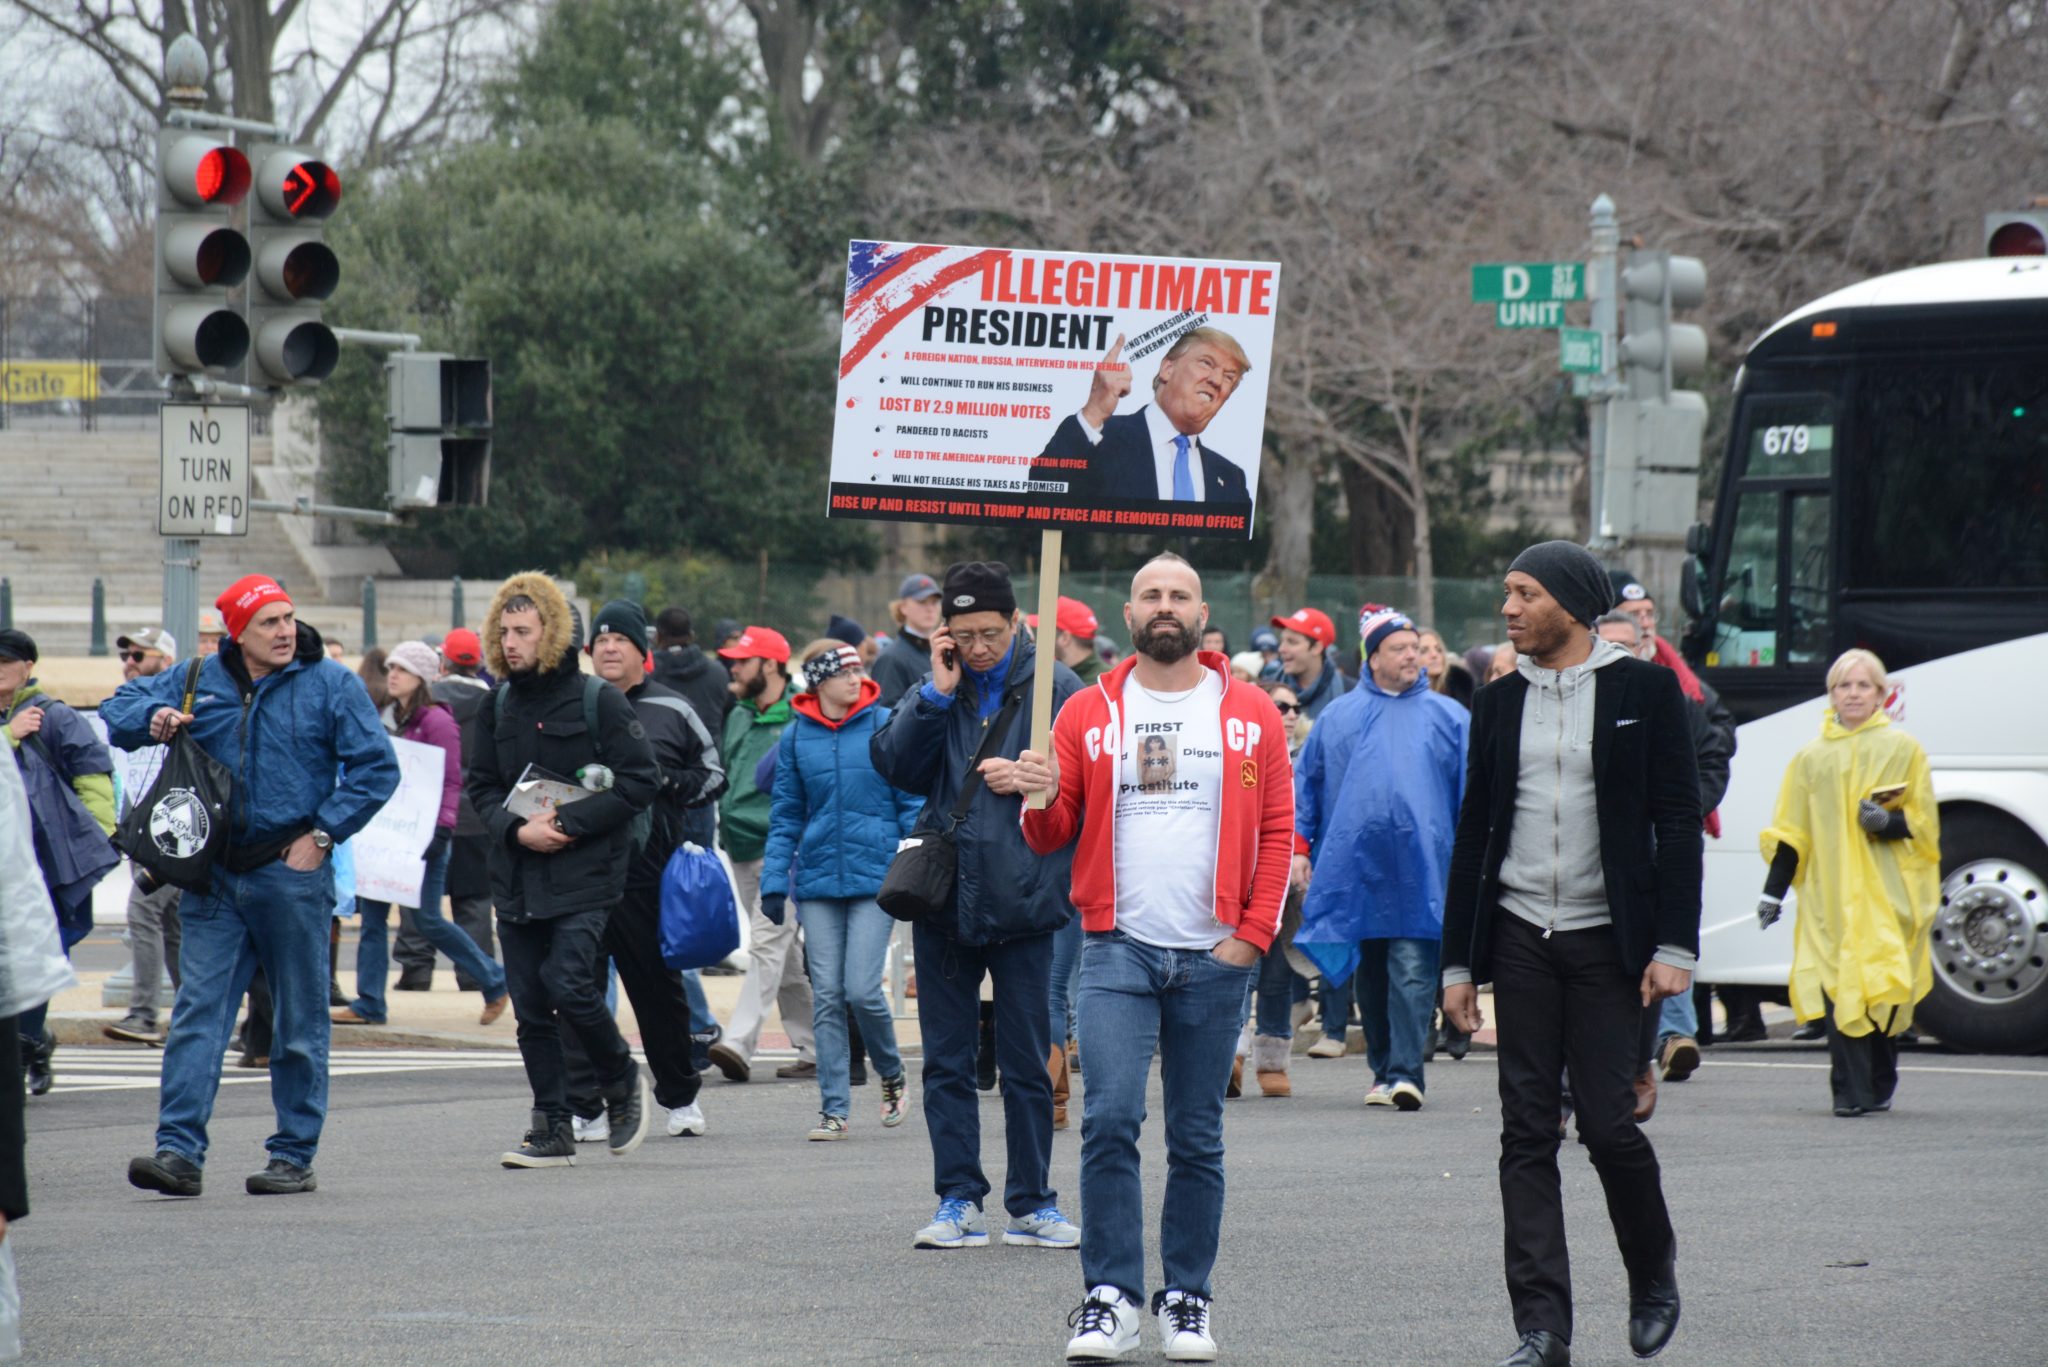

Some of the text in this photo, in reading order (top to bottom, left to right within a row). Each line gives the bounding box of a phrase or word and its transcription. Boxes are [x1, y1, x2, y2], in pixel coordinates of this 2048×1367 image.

[980, 252, 1272, 315] ILLEGITIMATE
[1503, 265, 1576, 299] D ST
[1500, 301, 1562, 326] UNIT
[922, 306, 1113, 351] PRESIDENT
[1123, 307, 1195, 352] #NOTMYPRESIDENT
[1129, 313, 1209, 362] #NEVERMYPRESIDENT
[904, 351, 910, 360] A
[912, 352, 946, 362] FOREIGN
[948, 354, 979, 365] NATION,
[981, 355, 1014, 367] RUSSIA,
[1016, 357, 1065, 369] INTERVENED
[1067, 360, 1078, 369] ON
[1080, 361, 1094, 371] HIS
[4, 369, 65, 394] Gate
[900, 376, 1053, 393] WILL CONTINUE TO RUN HIS BUSINESS
[879, 396, 1051, 420] LOST BY 2.9 MILLION VOTES
[190, 420, 221, 444] NO
[896, 425, 988, 439] PANDERED TO RACISTS
[1764, 424, 1809, 456] 679
[180, 458, 232, 482] TURN
[894, 449, 1088, 469] LIED TO THE AMERICAN PEOPLE TO ATTAIN OFFICE
[892, 474, 1065, 492] WILL NOT RELEASE HIS TAXES AS PROMISED
[169, 496, 195, 519] ON
[832, 495, 1245, 529] RISE UP AND RESIST UNTIL TRUMP AND PENCE ARE REMOVED FROM OFFICE
[1134, 722, 1183, 734] FIRST
[1183, 748, 1222, 758] Digge
[1120, 779, 1199, 794] Prostitute
